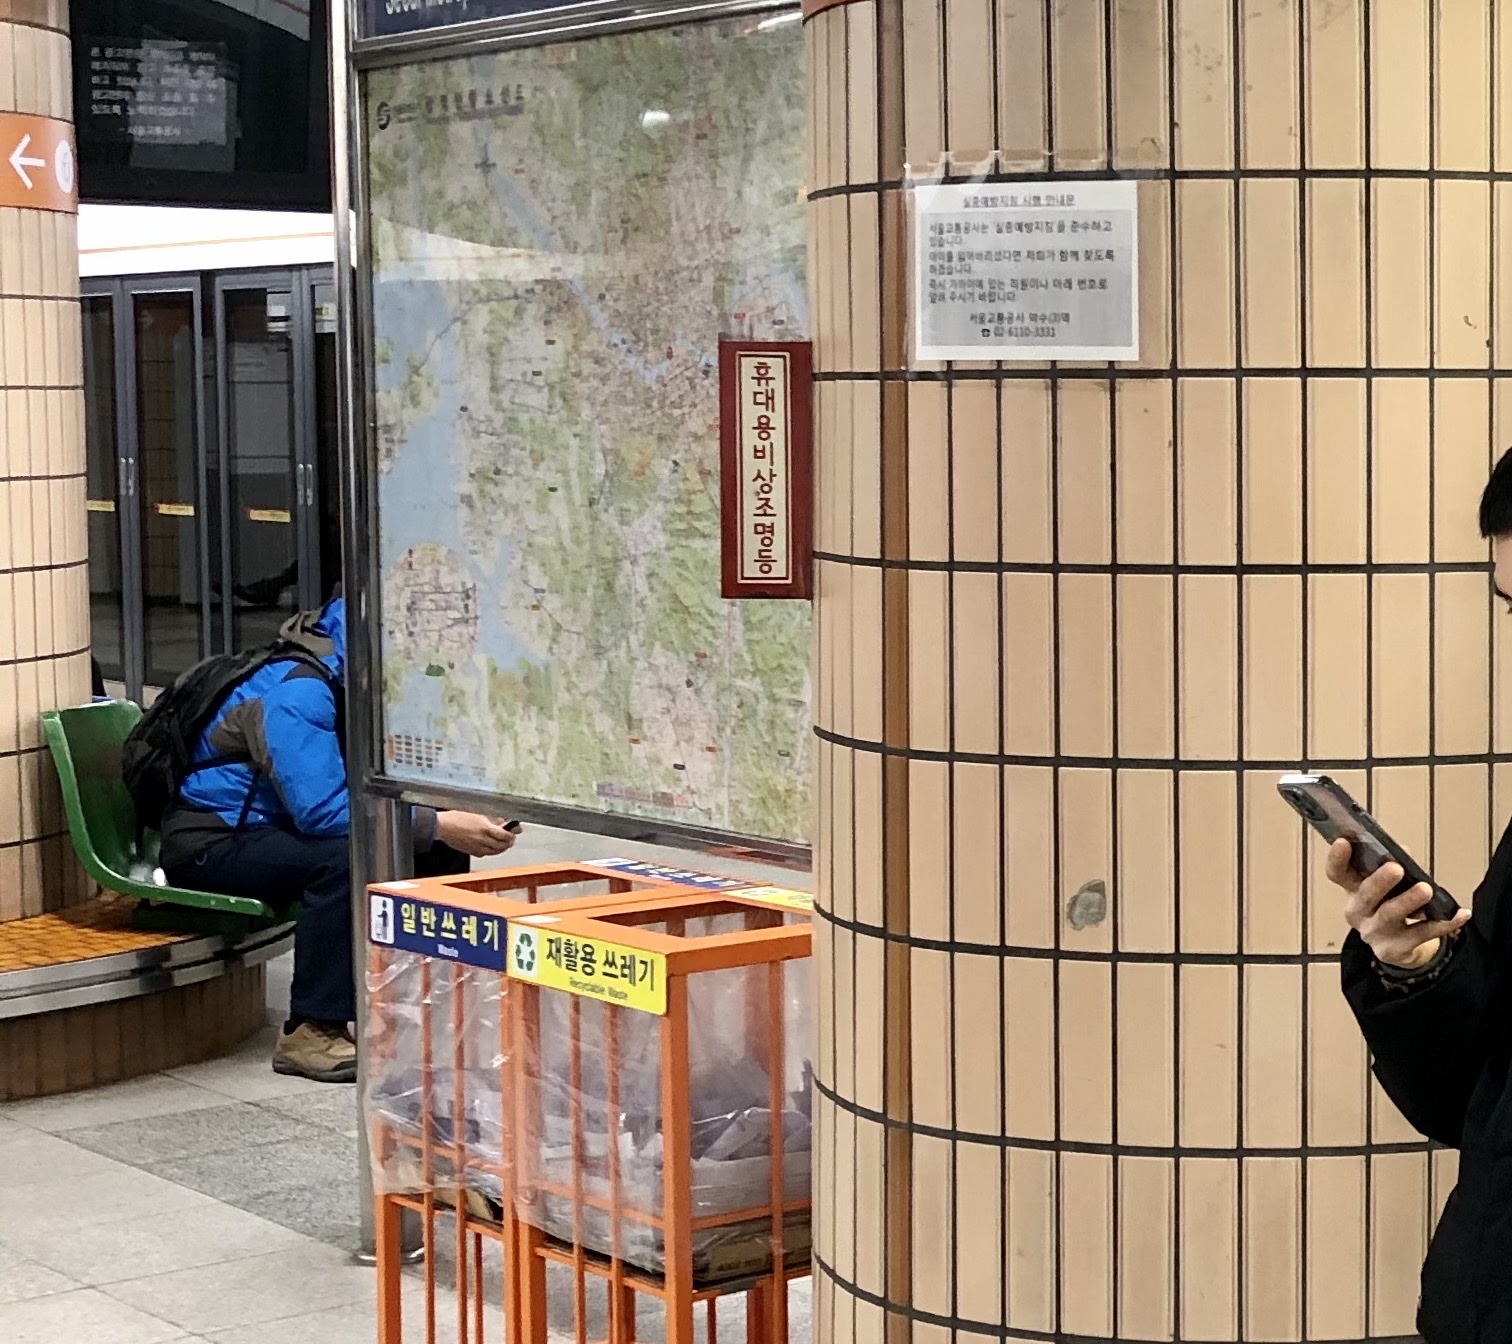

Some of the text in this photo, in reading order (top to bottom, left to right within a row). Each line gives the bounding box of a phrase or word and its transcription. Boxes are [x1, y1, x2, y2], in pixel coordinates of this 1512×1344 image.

[750, 360, 778, 575] 휴대용비상조명등
[400, 902, 499, 952] 일반쓰레기
[545, 936, 655, 992] 재활용 쓰레기
